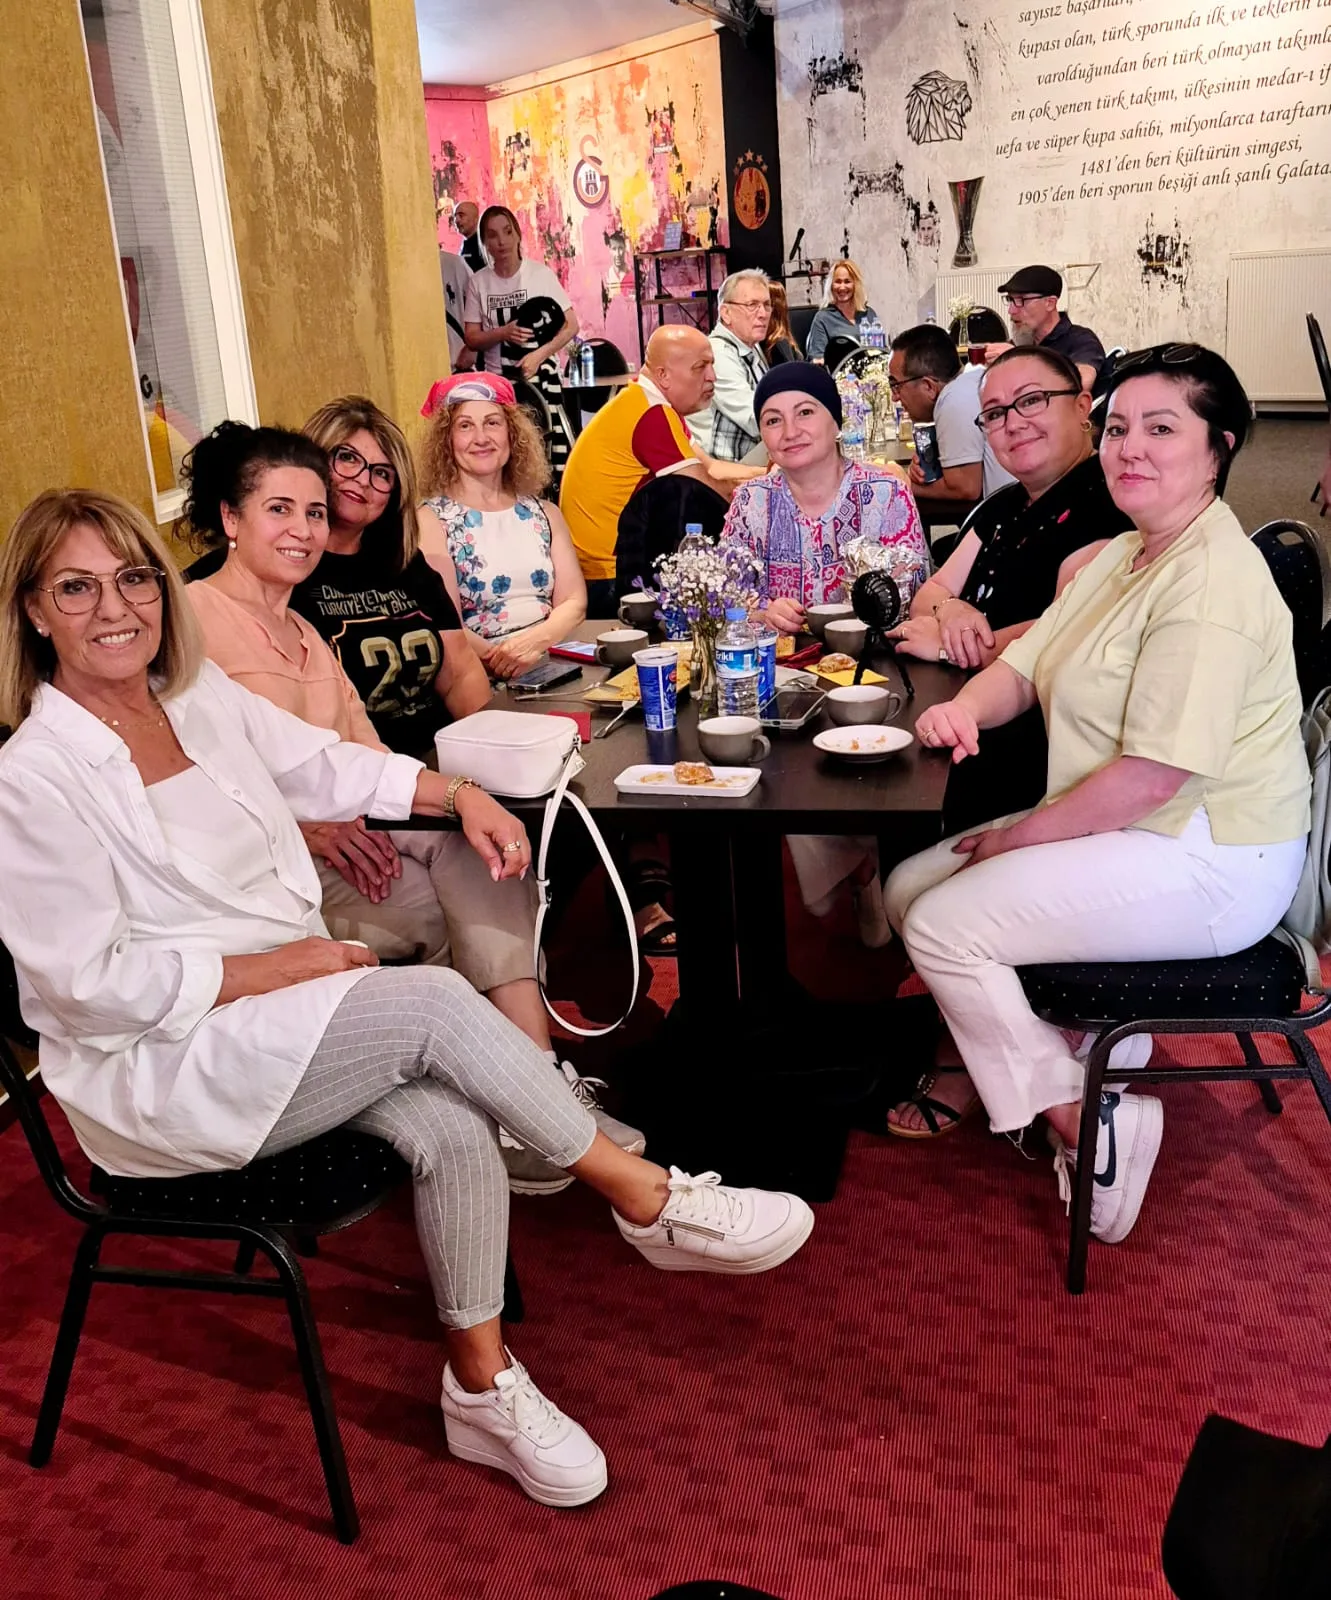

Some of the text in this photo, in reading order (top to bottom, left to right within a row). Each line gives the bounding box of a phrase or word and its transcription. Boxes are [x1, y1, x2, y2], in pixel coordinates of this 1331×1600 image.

[1018, 5, 1062, 26] sayısız
[1018, 38, 1060, 59] kupası
[1064, 30, 1096, 48] olan,
[1102, 21, 1134, 42] türk
[1135, 10, 1201, 41] sporunda
[1206, 5, 1229, 26] ilk
[1231, 8, 1247, 21] ve
[1037, 56, 1137, 85] varolduğundan
[1142, 50, 1168, 69] beri
[1172, 44, 1207, 65] türk
[1208, 40, 1271, 61] olmayan
[1011, 108, 1025, 121] en
[1029, 100, 1054, 122] çok
[1053, 102, 1091, 121] yenen
[1096, 90, 1128, 110] türk
[1129, 86, 1177, 107] takımı,
[1184, 75, 1251, 99] ülkesinin
[1256, 67, 1314, 88] medar-ı
[995, 137, 1022, 159] uefa
[1026, 139, 1040, 150] ve
[1043, 133, 1080, 152] süper
[1082, 127, 1115, 147] kupa
[1119, 119, 1164, 140] sahibi,
[1170, 110, 1254, 137] milyonlarca
[1080, 134, 1302, 176] 1481'den beri kültürün simgesi,
[1018, 159, 1331, 205] 1905'den beri sporun beşiği anlı şanlı Galata
